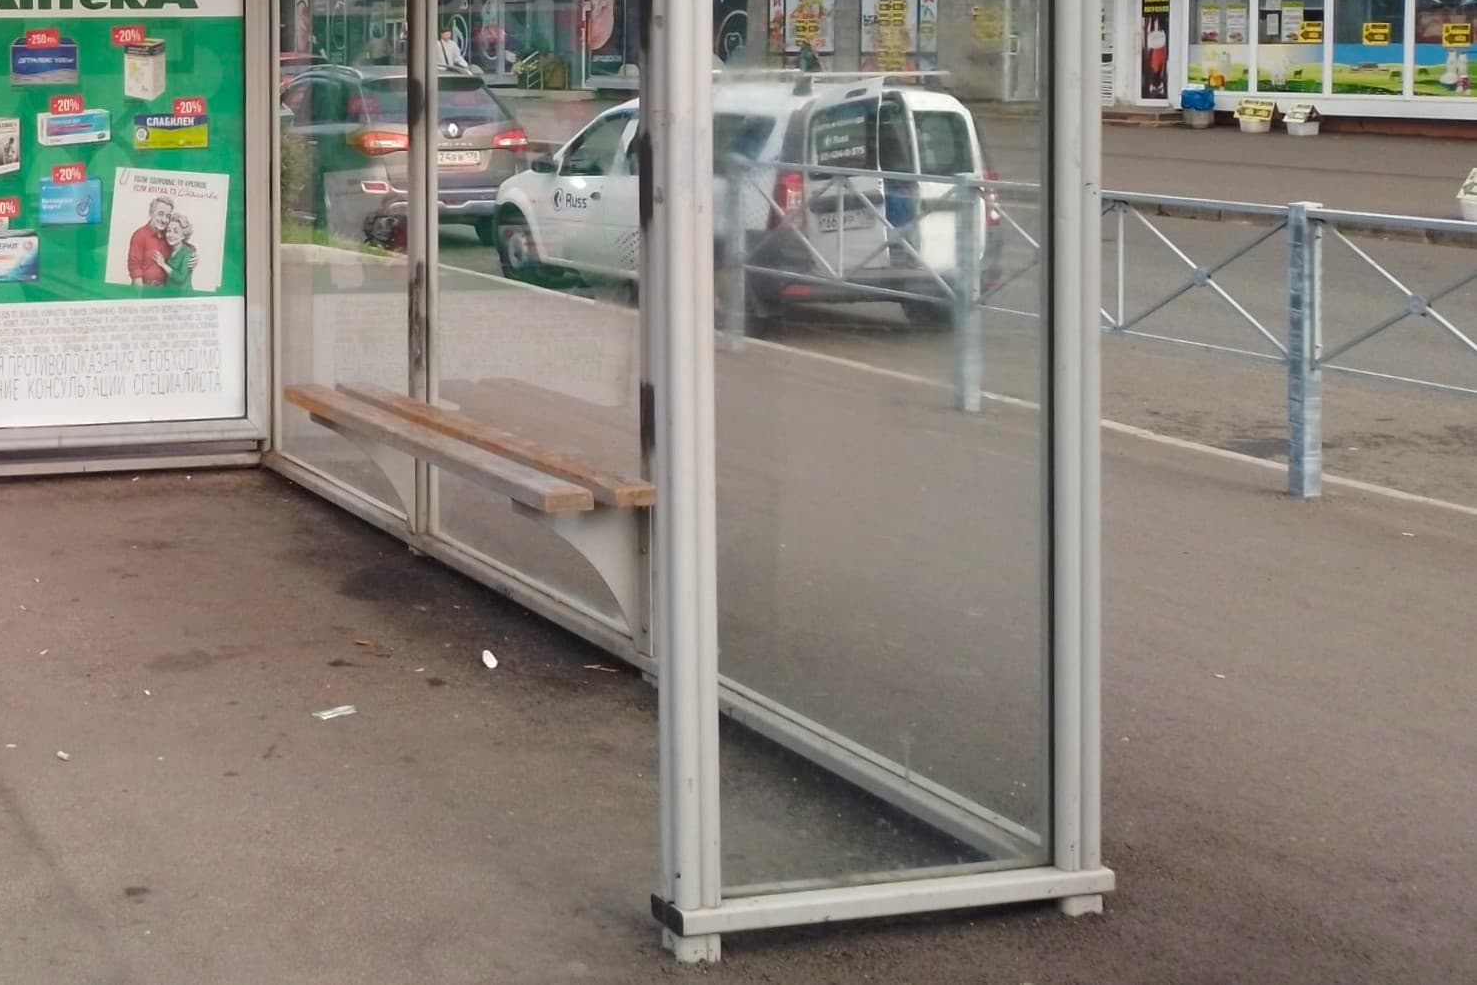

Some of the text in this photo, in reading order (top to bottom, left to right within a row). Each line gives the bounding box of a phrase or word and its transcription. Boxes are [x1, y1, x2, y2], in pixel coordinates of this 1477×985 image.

[114, 28, 141, 43] -20%
[53, 98, 79, 112] -20%
[175, 100, 202, 114] -20%
[146, 117, 195, 127] СЛАБИЛЕН
[55, 166, 82, 180] -20%
[565, 193, 587, 209] Russ
[141, 347, 222, 372] НЕОБХОДИМО
[27, 374, 125, 400] КОНСУЛЬТАЦИИ
[133, 371, 222, 396] СПЕЦИАЛИСТА
